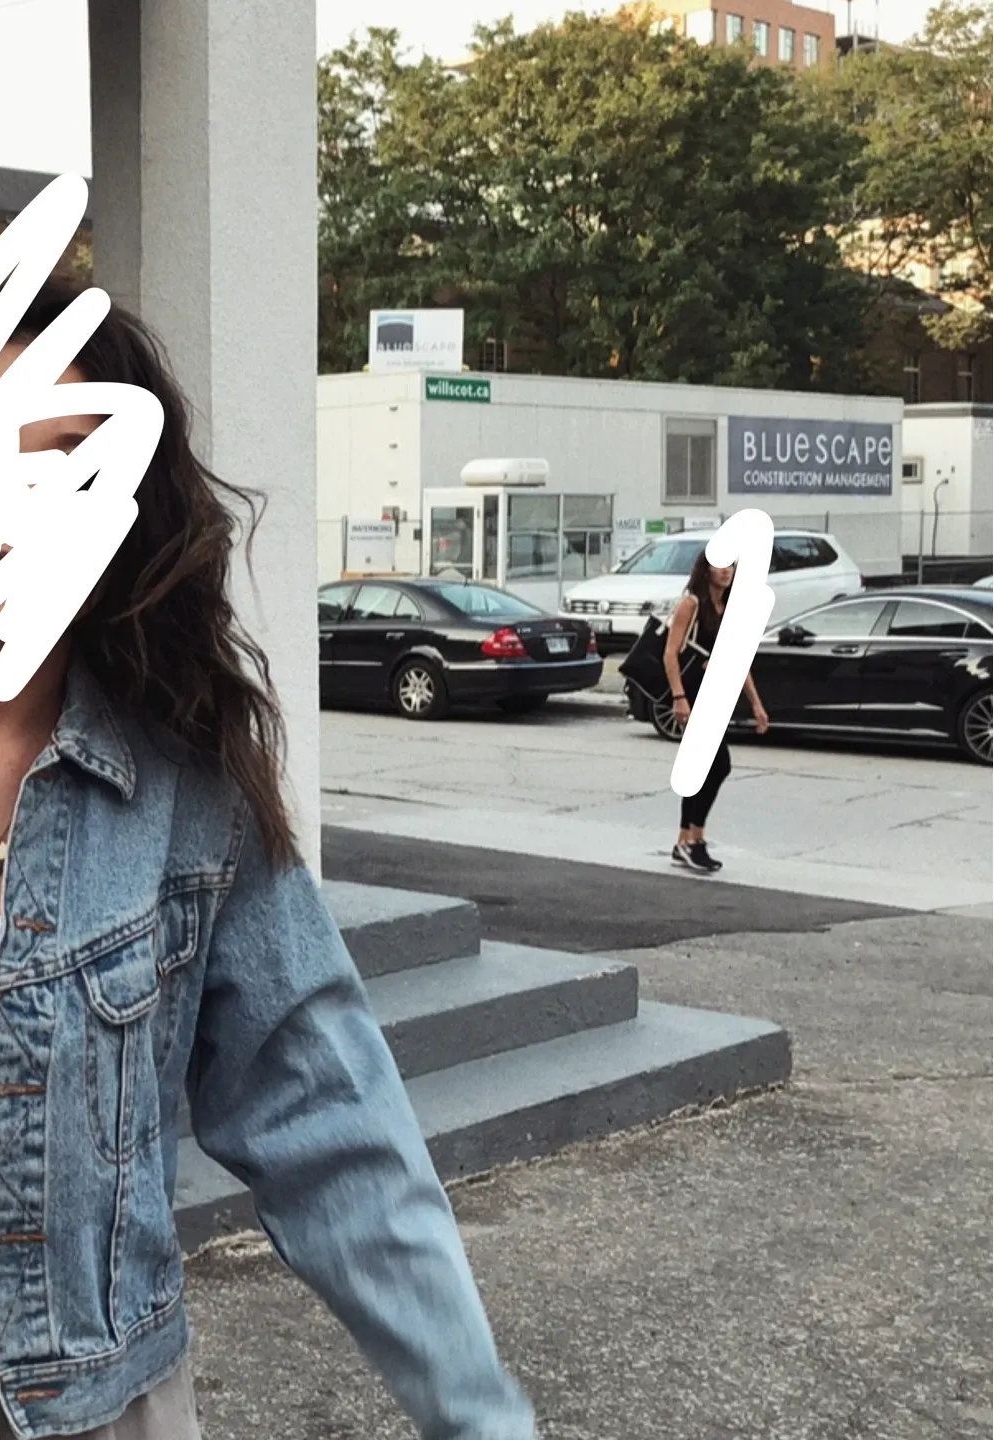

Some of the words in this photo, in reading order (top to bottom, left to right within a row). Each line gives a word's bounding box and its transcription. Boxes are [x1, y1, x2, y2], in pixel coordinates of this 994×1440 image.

[427, 380, 489, 398] willscot.ca
[743, 470, 822, 487] CONSTRUCTION
[824, 472, 891, 488] MANAGEMENT
